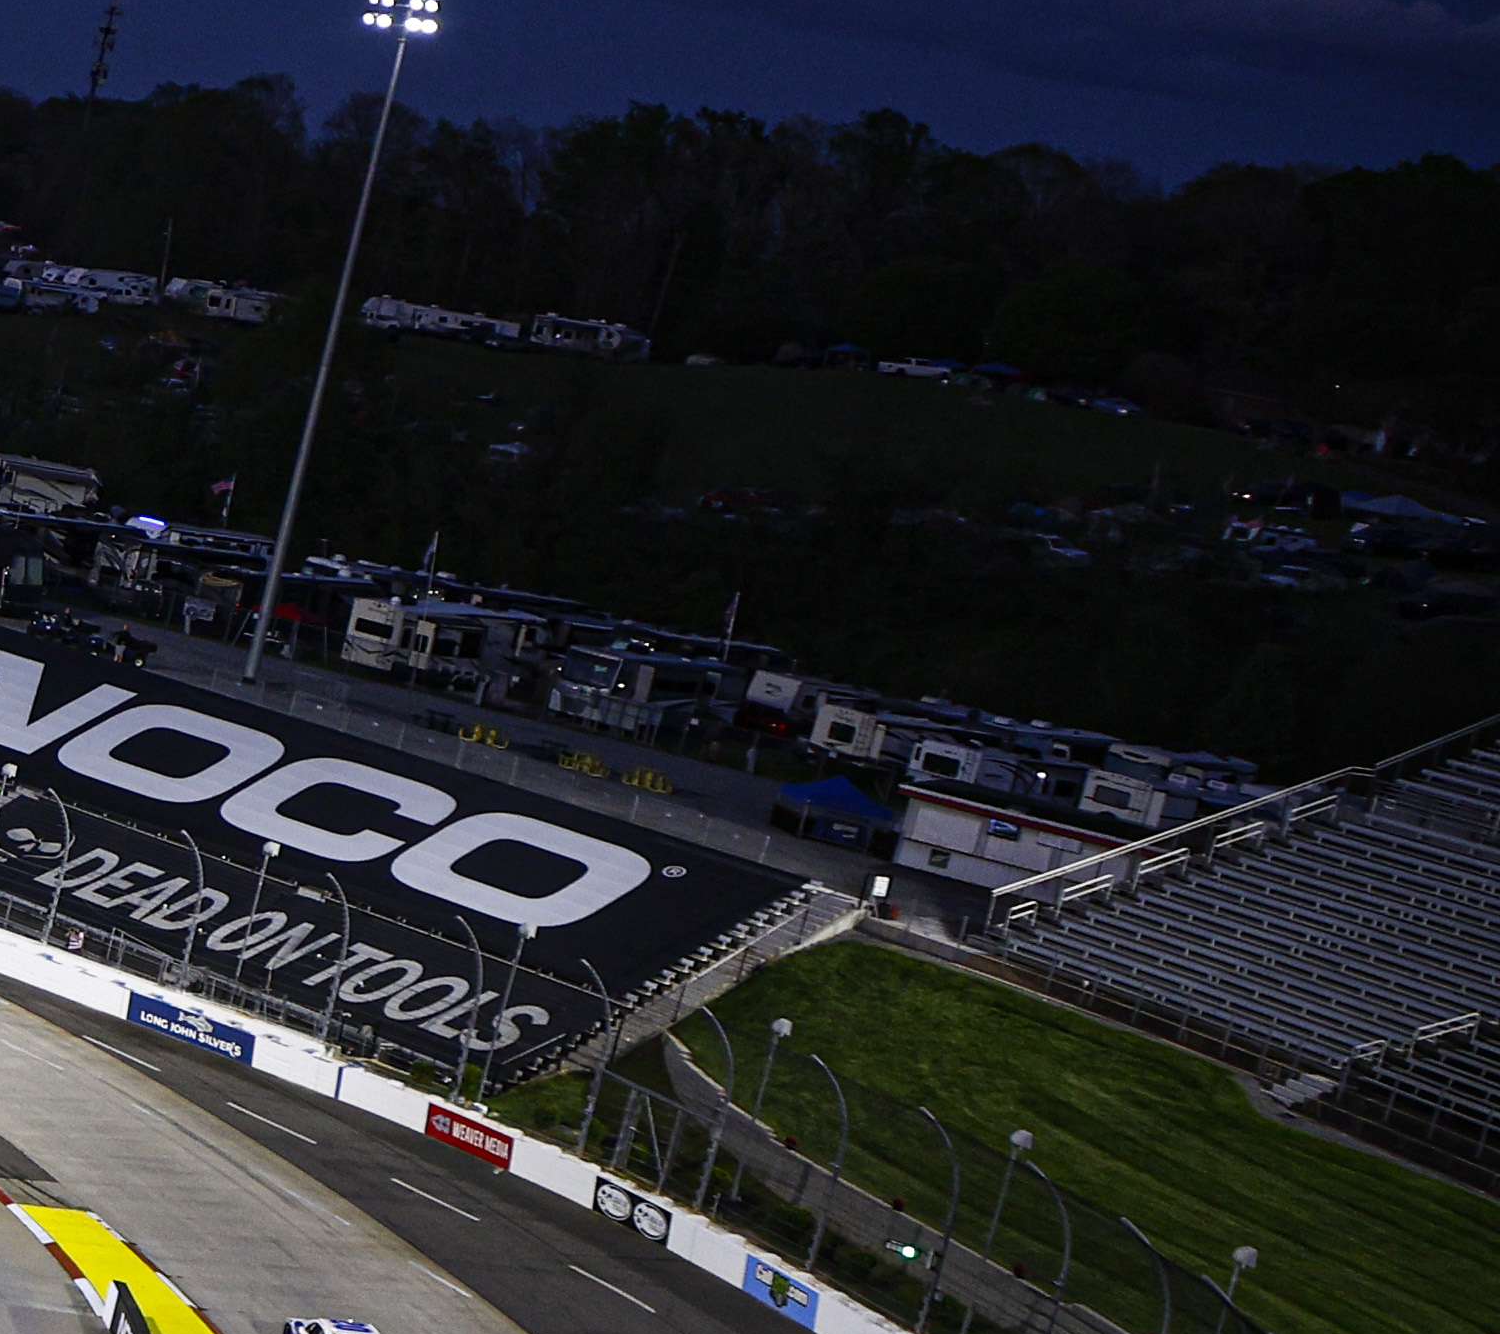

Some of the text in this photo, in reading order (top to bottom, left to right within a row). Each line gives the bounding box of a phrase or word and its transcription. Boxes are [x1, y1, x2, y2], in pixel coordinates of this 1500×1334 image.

[34, 848, 550, 1051] DEAD ON TOOLS
[139, 1010, 243, 1059] LONG JOHN SILVER'S
[451, 1120, 510, 1161] WEAVER MEDIA
